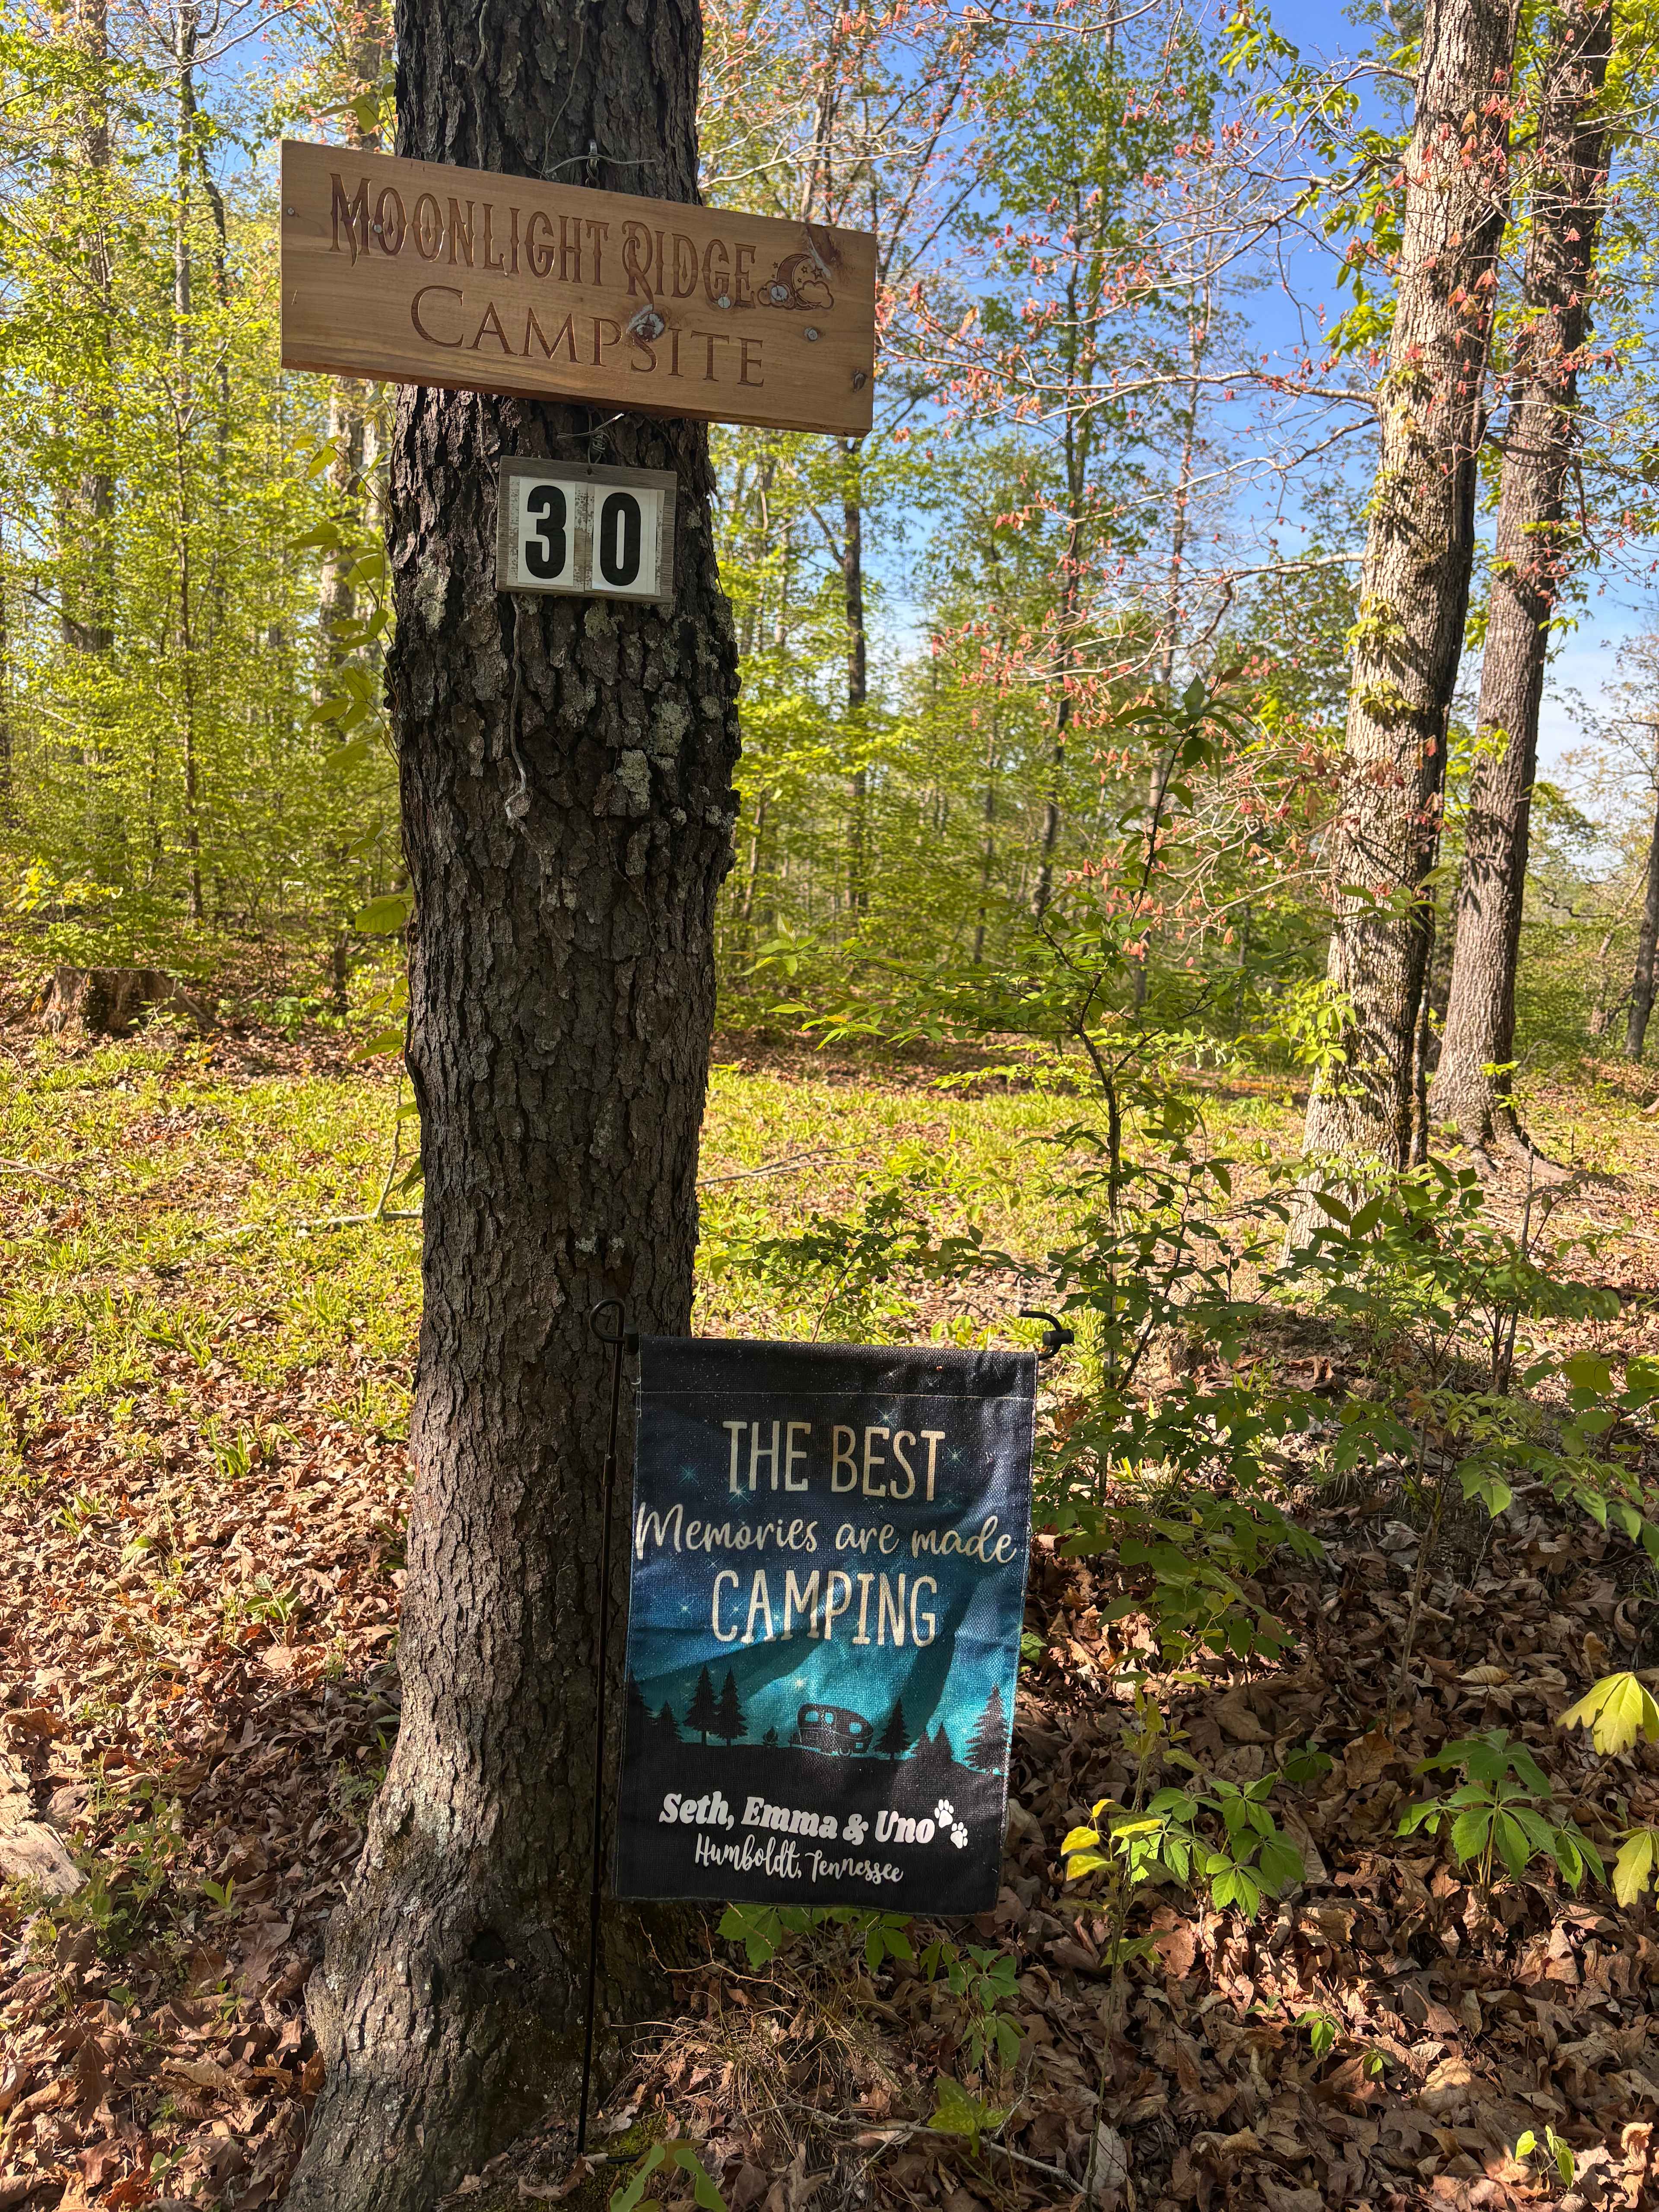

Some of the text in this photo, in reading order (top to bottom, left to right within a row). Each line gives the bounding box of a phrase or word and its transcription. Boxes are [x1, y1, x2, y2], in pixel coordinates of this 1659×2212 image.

[525, 485, 641, 586] 30
[723, 1421, 945, 1501] THE BEST
[636, 1502, 1017, 1564] Memories are made
[712, 1569, 938, 1648] CAMPING
[659, 1791, 936, 1846] Seth, Emma & Uno
[695, 1833, 904, 1884] Humboldt, Tennessee
